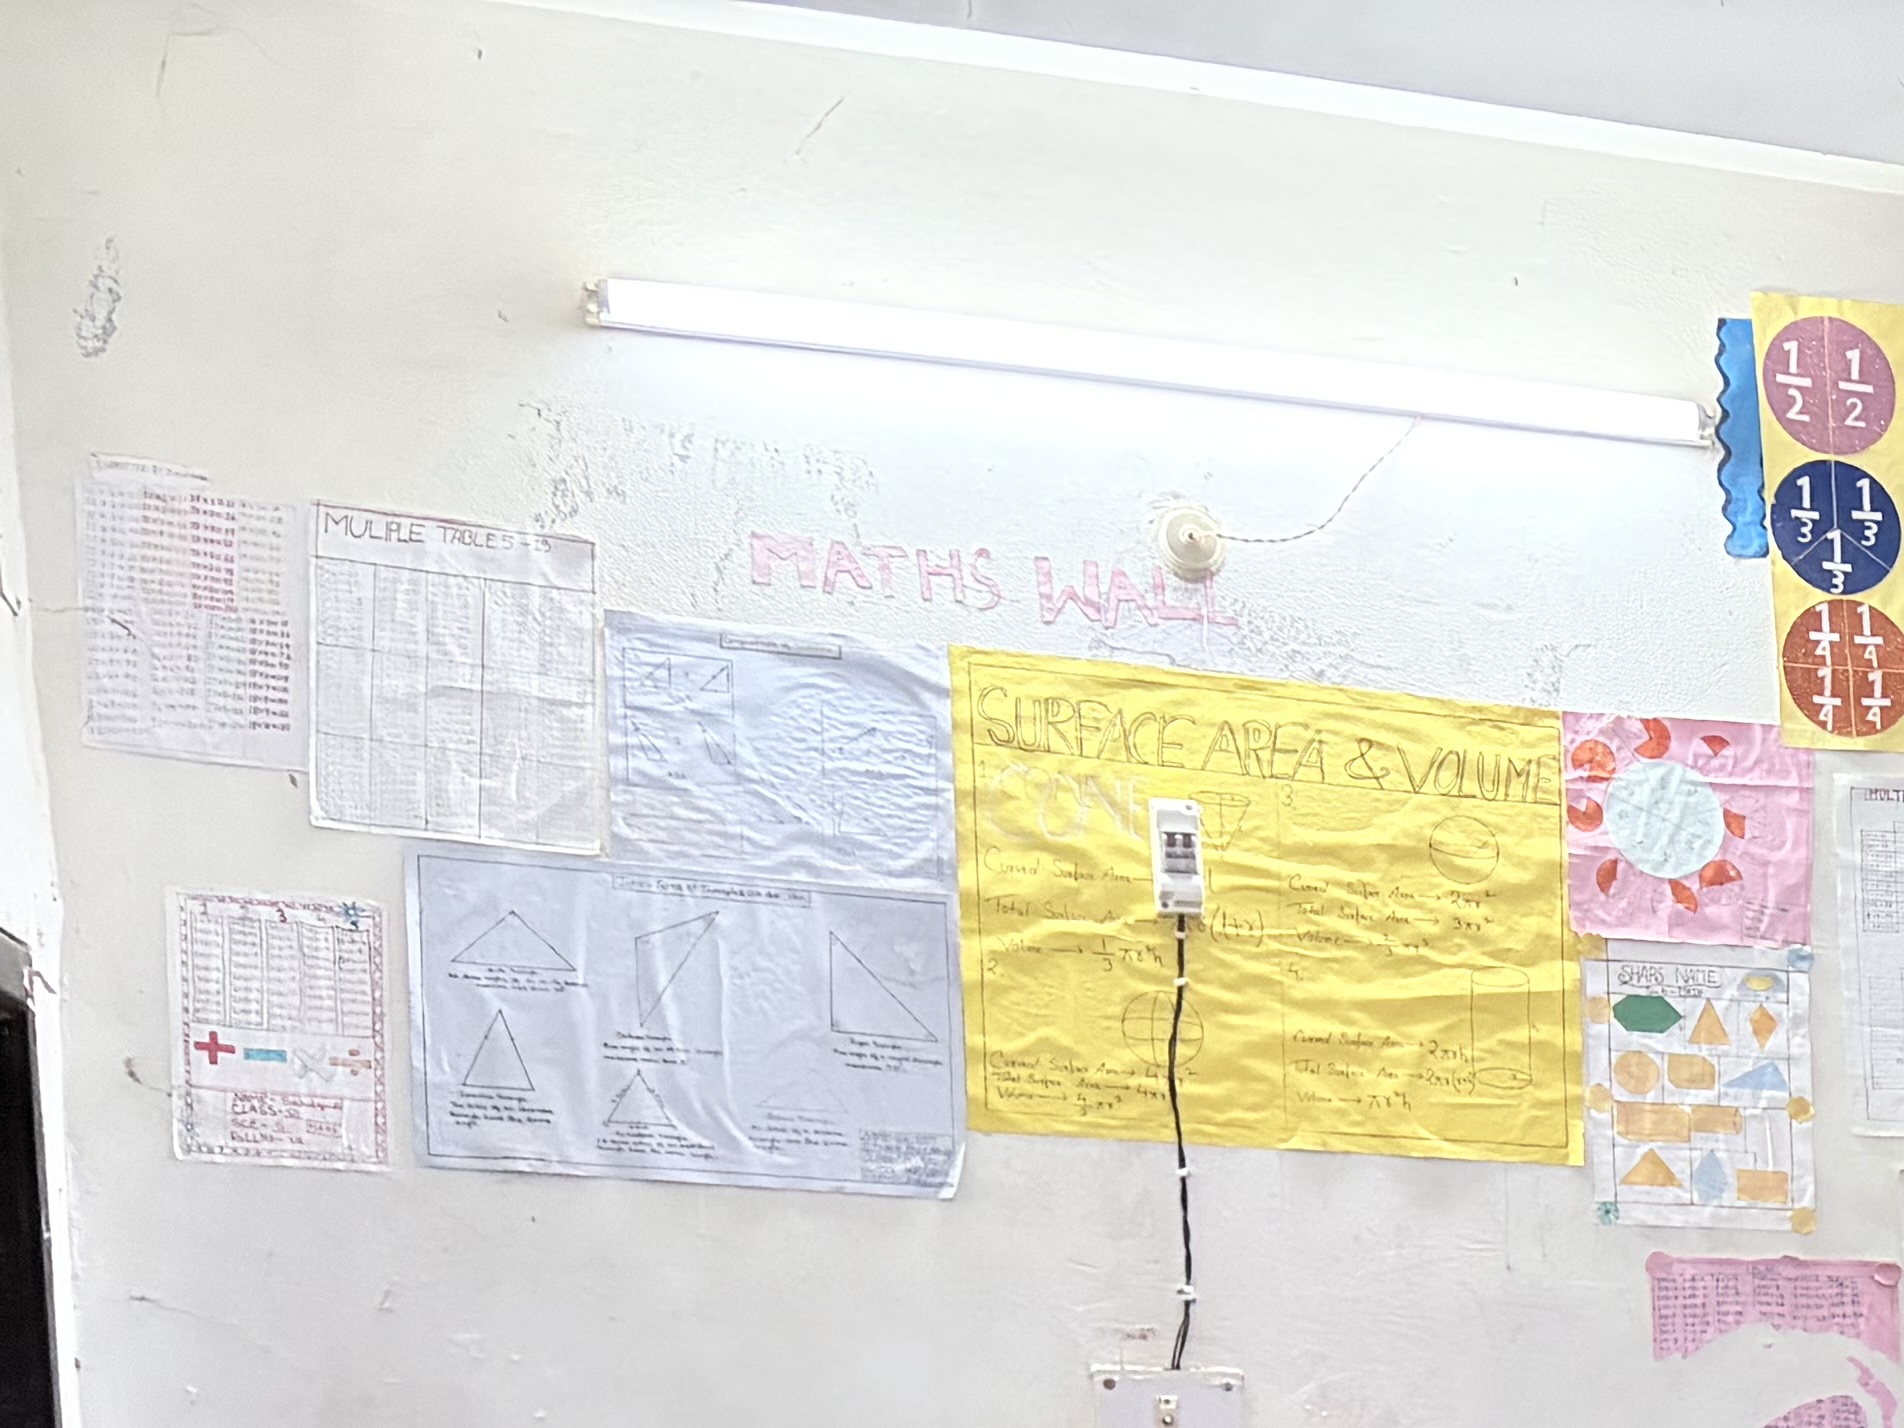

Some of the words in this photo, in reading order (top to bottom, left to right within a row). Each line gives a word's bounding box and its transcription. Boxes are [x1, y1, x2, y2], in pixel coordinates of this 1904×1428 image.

[749, 530, 1003, 611] MATHS
[1034, 555, 1239, 628] WALL
[977, 686, 1196, 769] SURFACE
[1202, 719, 1325, 785] AREA
[1344, 738, 1391, 790] &
[1397, 744, 1558, 805] VOLUME
